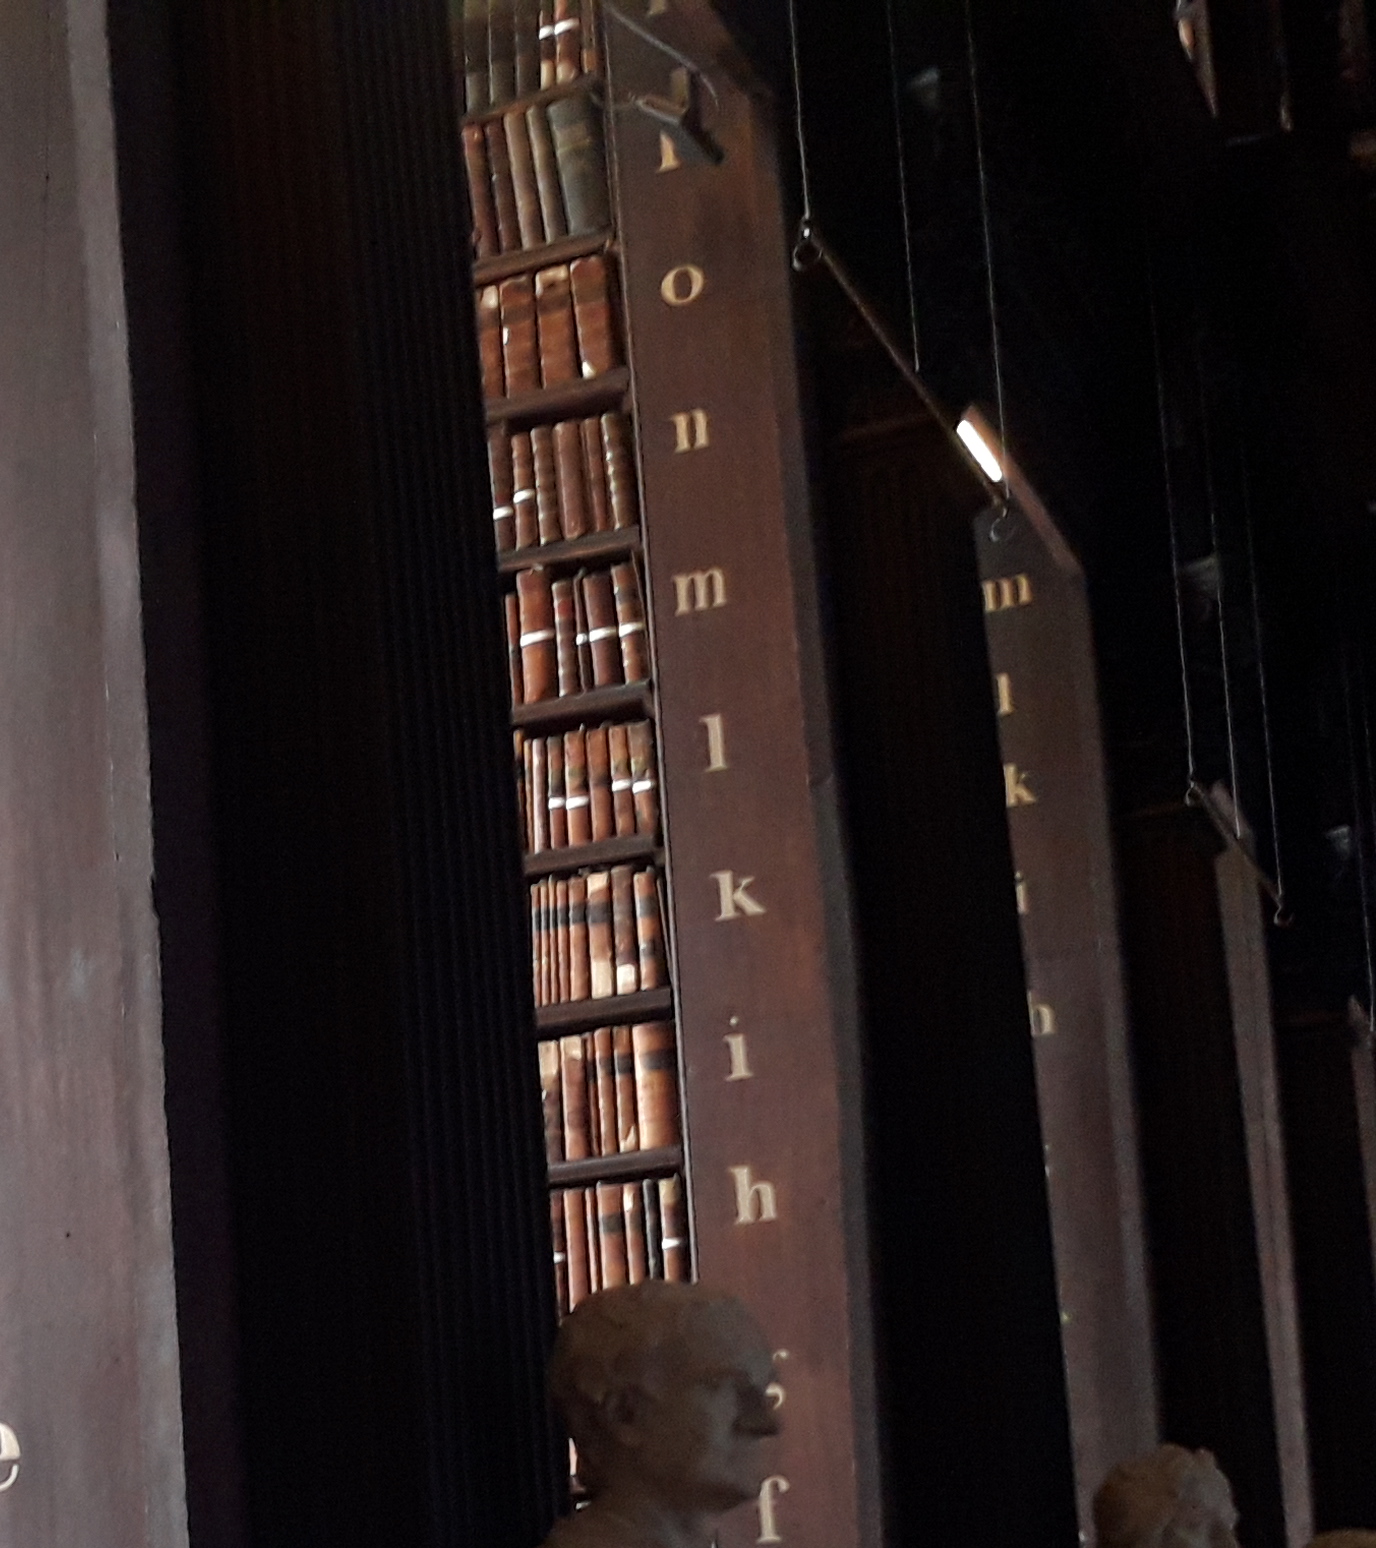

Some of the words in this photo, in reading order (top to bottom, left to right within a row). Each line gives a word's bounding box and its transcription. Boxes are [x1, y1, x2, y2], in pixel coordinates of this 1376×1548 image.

[660, 264, 705, 306] o
[666, 407, 711, 453] n
[672, 566, 727, 617] m
[982, 572, 1034, 613] m
[699, 713, 728, 773] l
[1003, 762, 1038, 808] k
[709, 869, 766, 923] k
[722, 1015, 754, 1082] i
[728, 1165, 778, 1225] h
[755, 1474, 790, 1545] f
